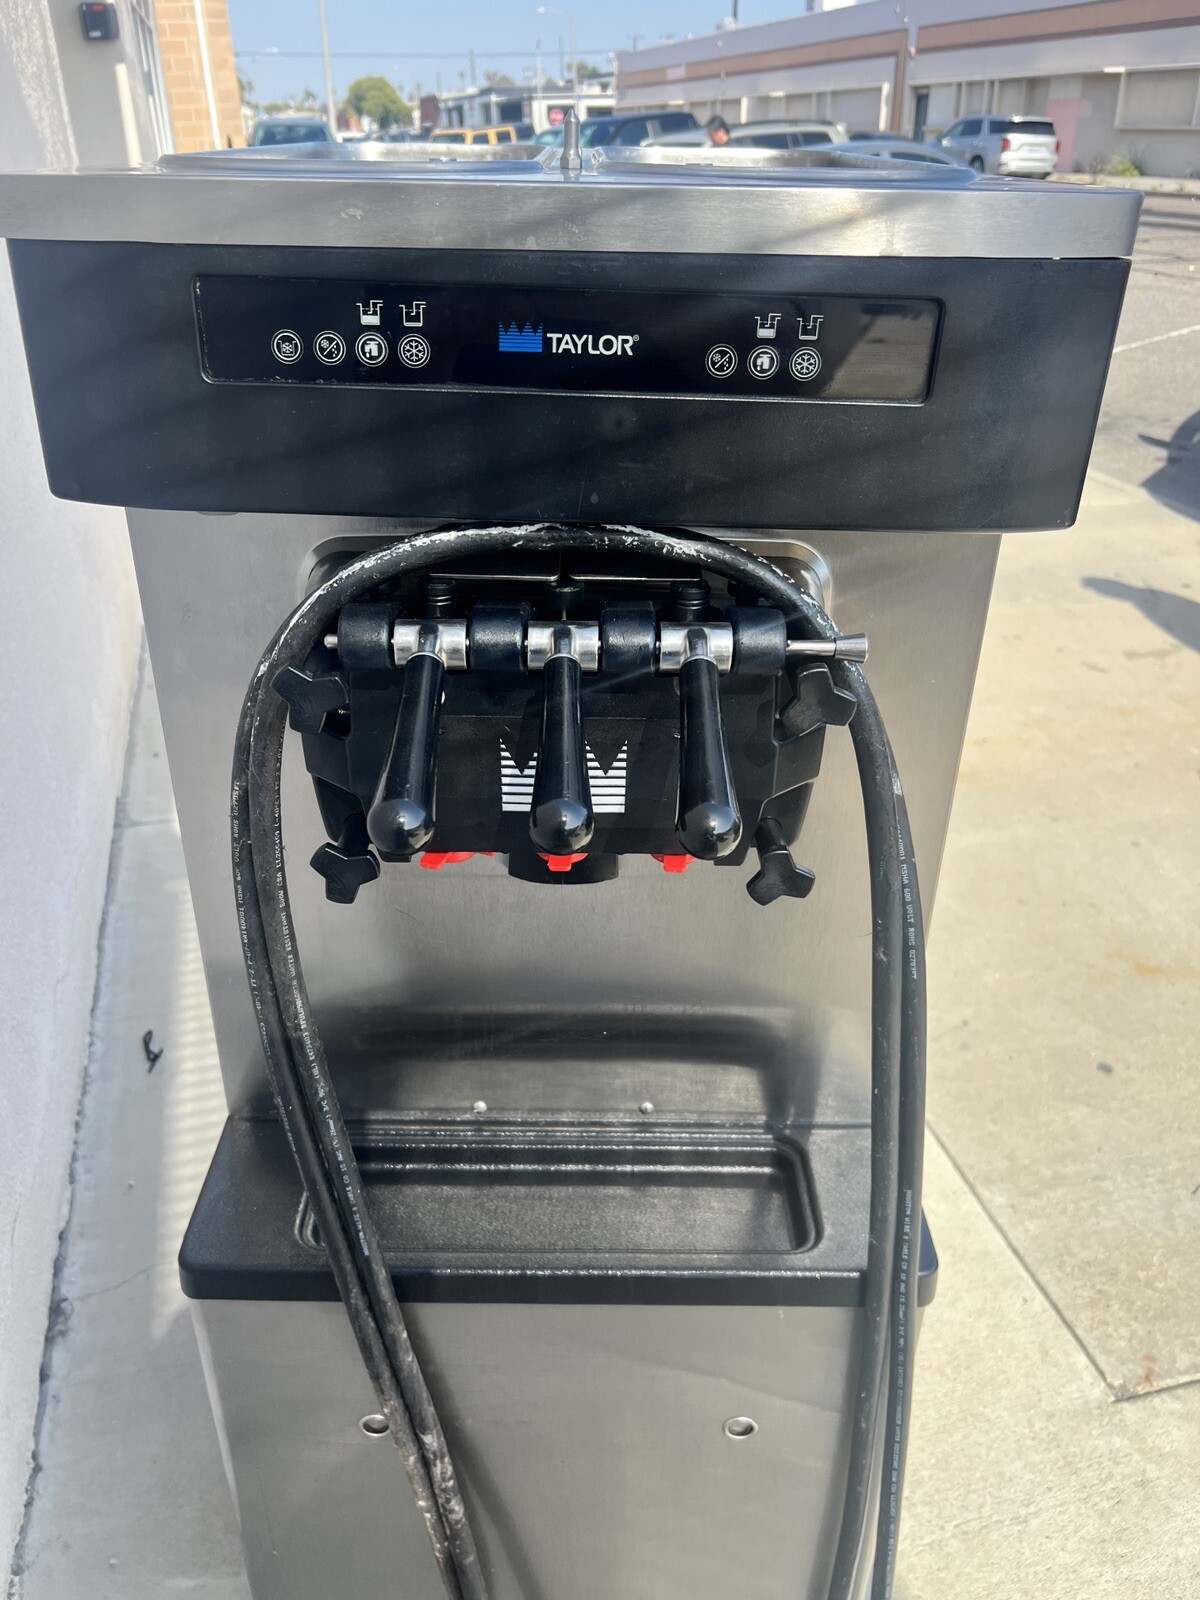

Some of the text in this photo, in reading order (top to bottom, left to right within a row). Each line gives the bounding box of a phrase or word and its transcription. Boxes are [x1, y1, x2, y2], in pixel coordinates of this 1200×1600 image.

[546, 333, 634, 356] TAYLOR
[900, 863, 909, 885] MSHA
[904, 888, 912, 902] 600
[906, 904, 914, 924] VOLT
[280, 911, 292, 952] RESISTANT
[908, 927, 916, 946] ROHS
[287, 954, 296, 977] WATER
[311, 1062, 320, 1079] (UL)
[345, 1185, 356, 1205] CABLE
